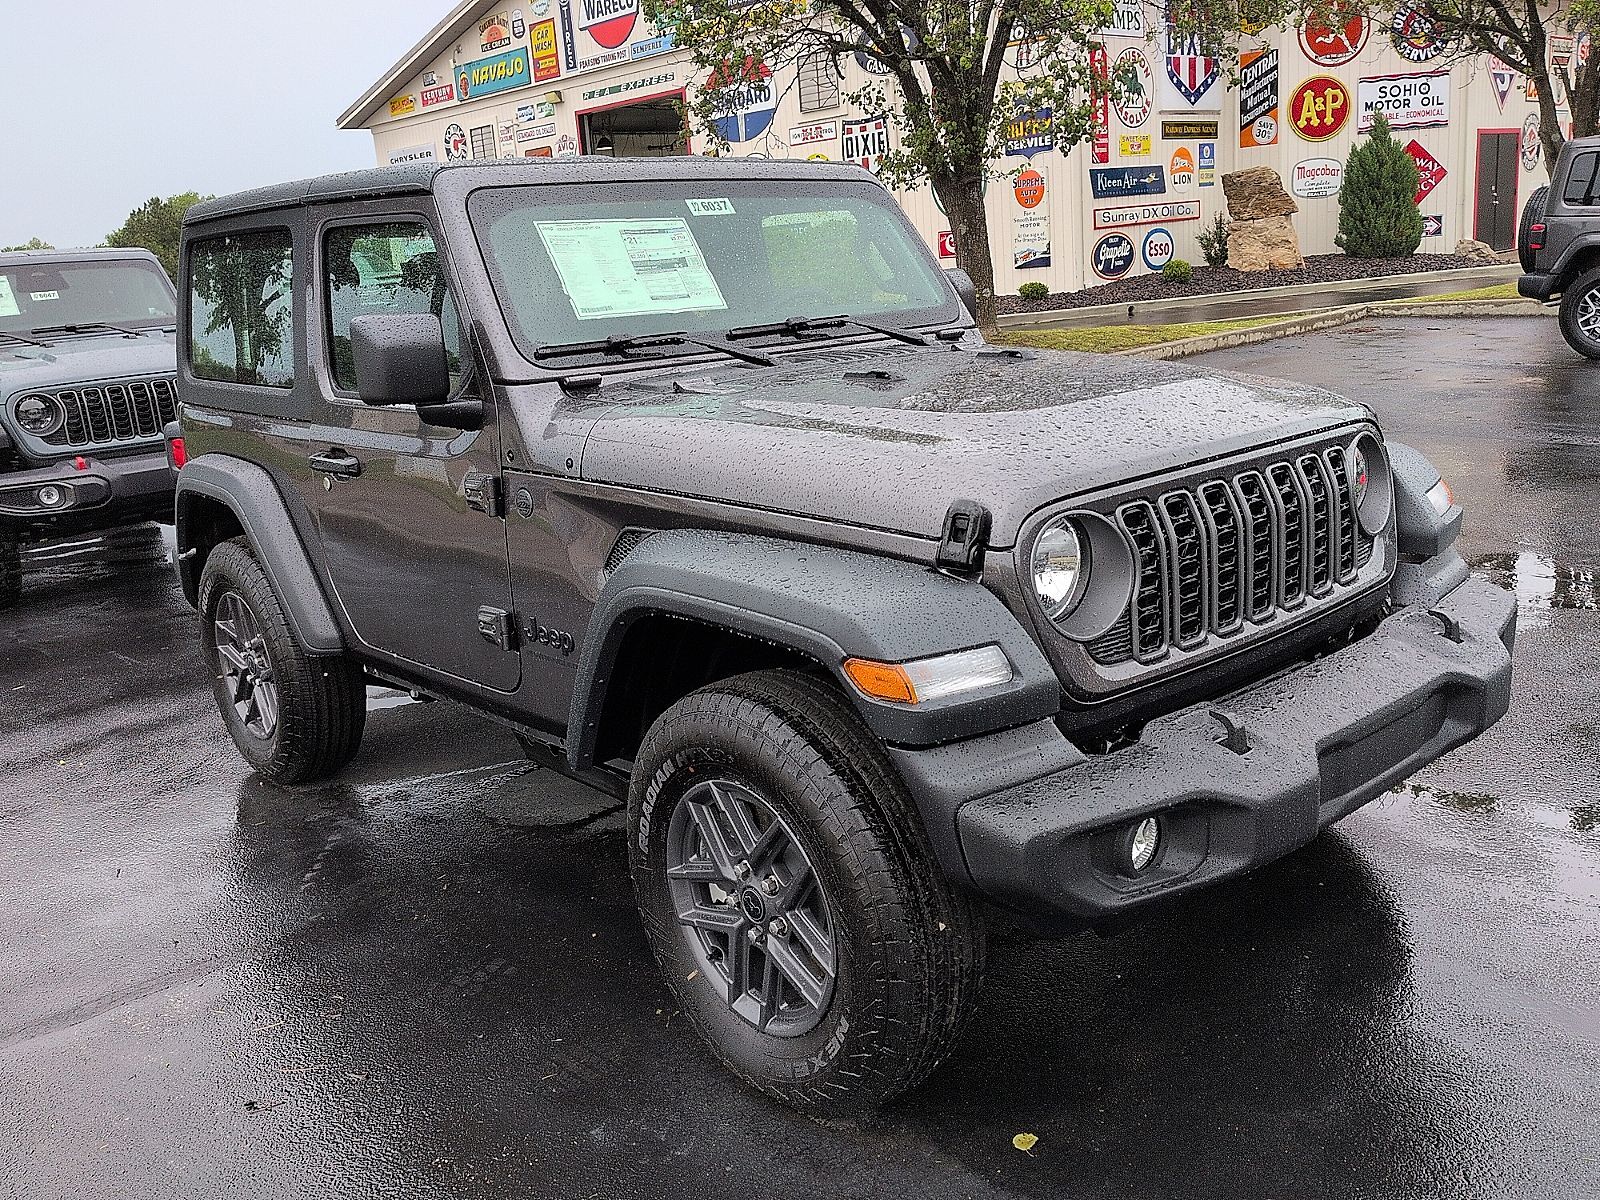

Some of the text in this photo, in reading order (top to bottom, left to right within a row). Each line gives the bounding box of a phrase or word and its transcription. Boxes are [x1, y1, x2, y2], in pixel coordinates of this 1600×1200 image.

[536, 29, 549, 41] CAR
[562, 7, 574, 67] TIRES
[482, 38, 510, 52] ICE CREAM
[535, 40, 552, 53] WASH
[1396, 40, 1446, 61] SERVICE
[617, 49, 627, 60] POST
[471, 57, 523, 86] NAVAJO
[1241, 51, 1278, 88] CENTRAL
[620, 72, 675, 92] EXPRESS
[1240, 69, 1278, 102] Manufacturers
[1378, 82, 1431, 99] SOHIO
[1247, 84, 1271, 109] Mutual
[1364, 96, 1445, 112] MOTOR OIL
[1241, 100, 1269, 126] Insurance
[1297, 88, 1345, 129] A&P
[1362, 109, 1445, 123] DEPDABLE ECONOMICAL
[1184, 125, 1201, 133] EXPRESS
[1202, 125, 1217, 133] AGENCY
[1257, 121, 1274, 130] SAVE
[844, 130, 886, 159] DIXIE
[389, 150, 432, 165] CHRYSLER
[1173, 174, 1192, 185] LION
[1296, 164, 1340, 181] Magcobar
[1012, 177, 1045, 189] SUPREME
[1020, 189, 1038, 197] AUTO
[701, 199, 729, 212] 6037
[1102, 204, 1194, 223] Sunray DX Oil Co.
[1097, 240, 1131, 271] Grapette
[523, 616, 575, 656] Jeep
[638, 758, 676, 854] ROADIAN
